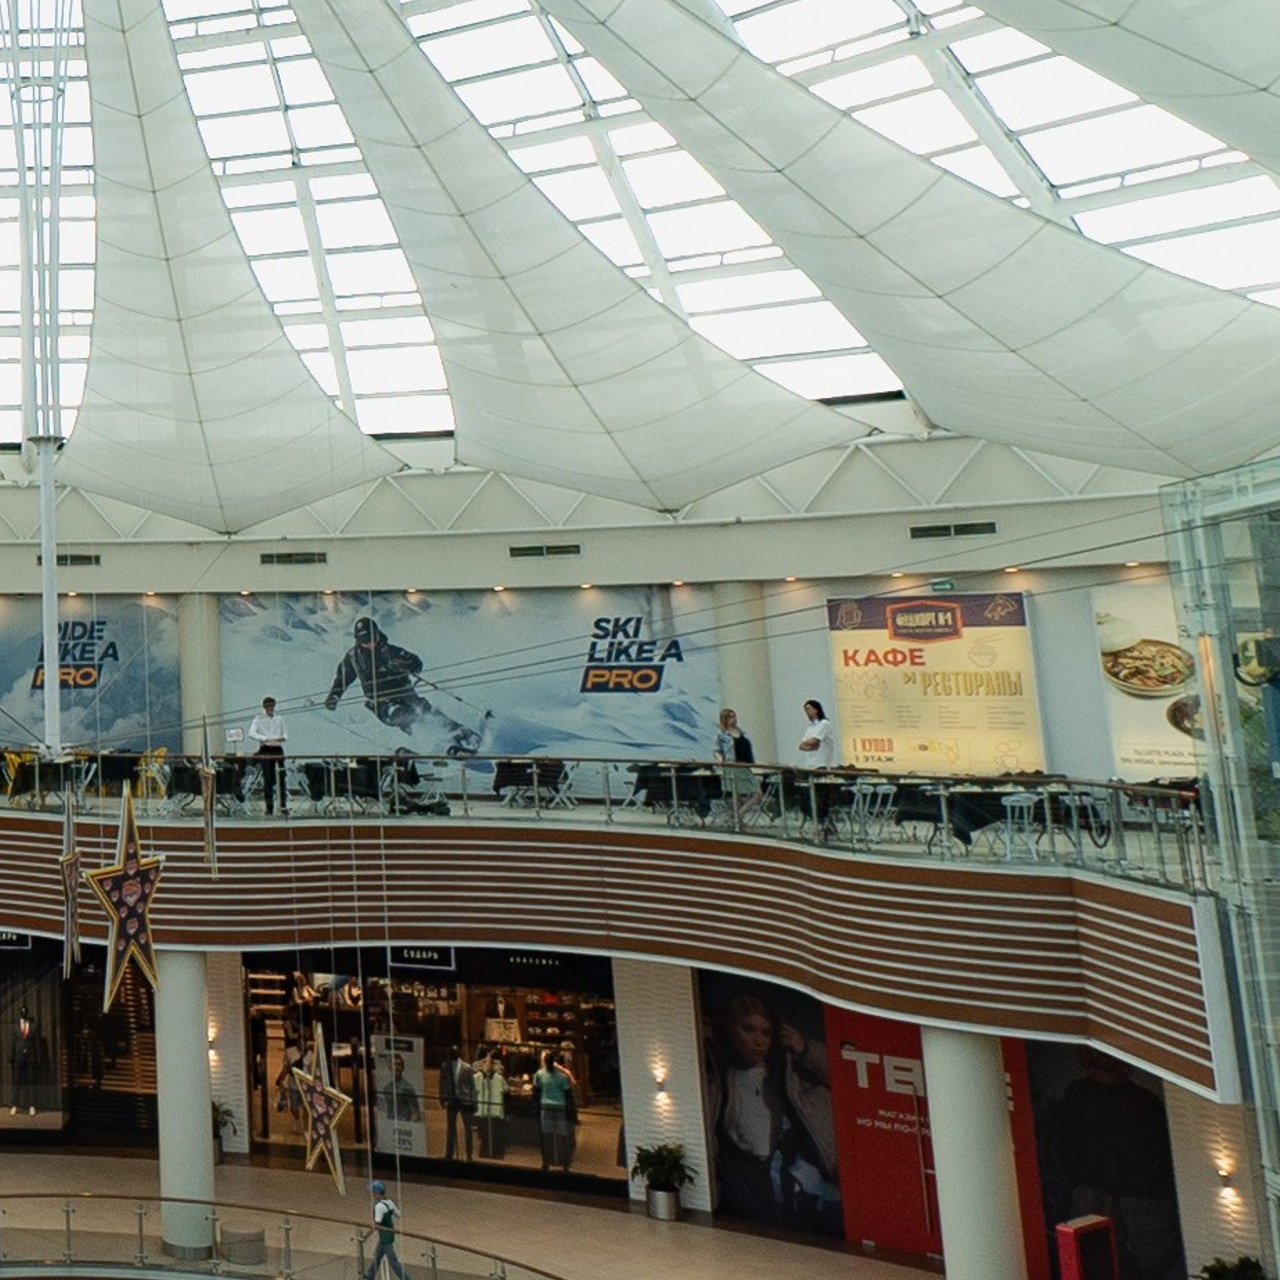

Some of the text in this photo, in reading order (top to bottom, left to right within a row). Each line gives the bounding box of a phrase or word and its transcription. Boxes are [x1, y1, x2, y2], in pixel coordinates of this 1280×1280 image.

[57, 621, 107, 641] IDE
[591, 616, 643, 639] SKI
[98, 641, 119, 662] A
[587, 640, 684, 662] LIKE A
[842, 647, 926, 667] КАФЕ
[585, 669, 658, 689] PRO
[922, 671, 1023, 696] РЕСТОРАНЫ
